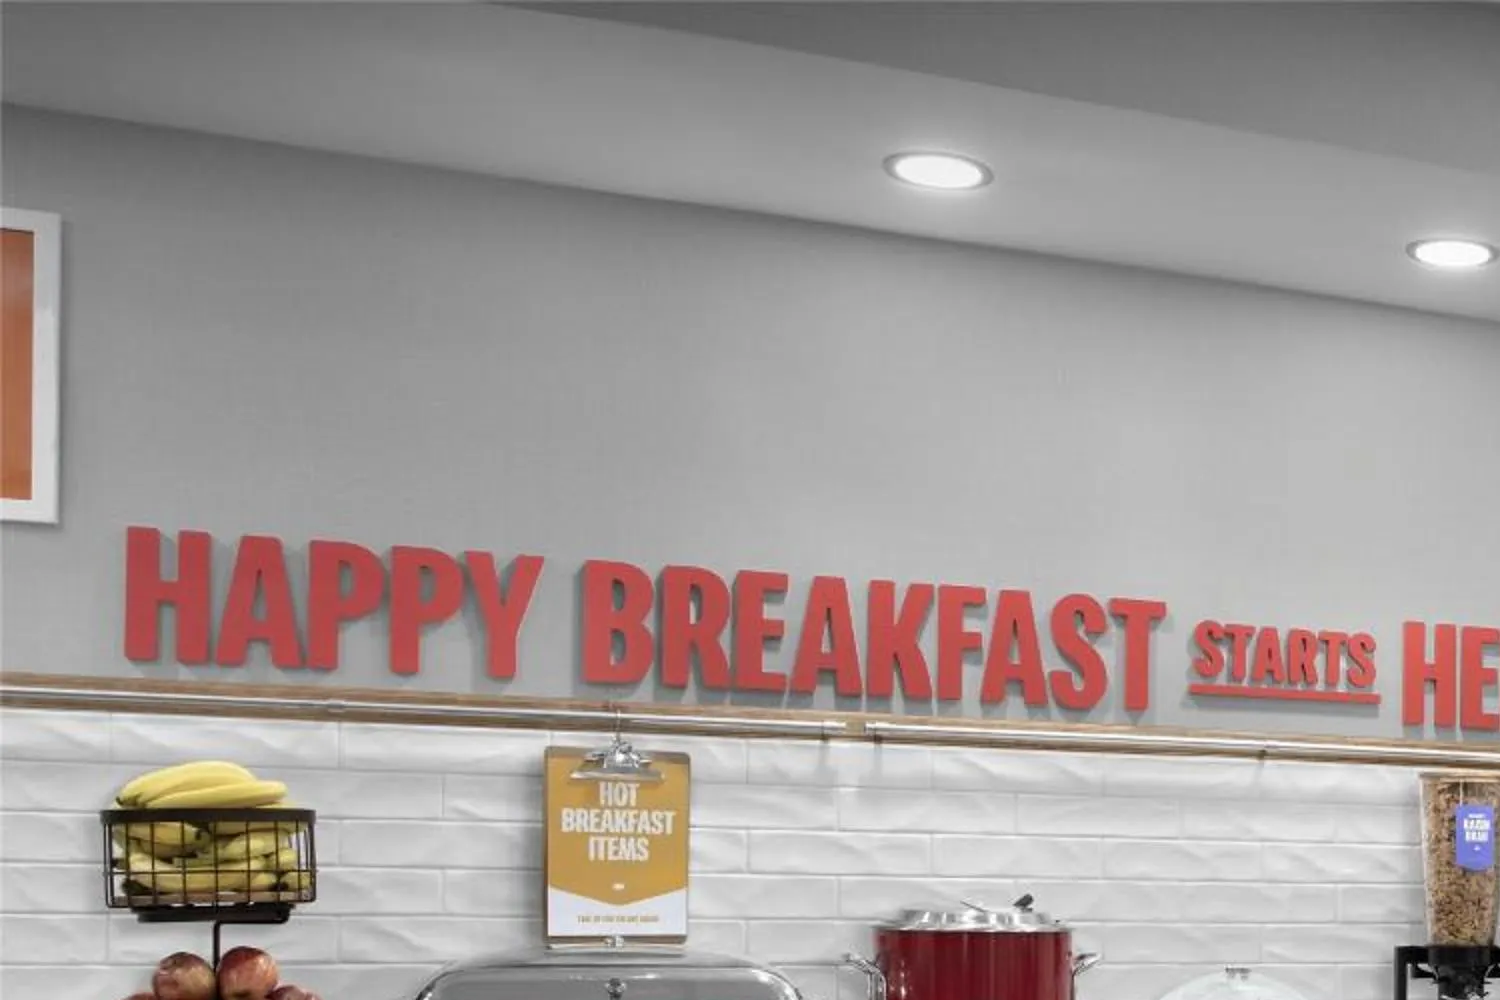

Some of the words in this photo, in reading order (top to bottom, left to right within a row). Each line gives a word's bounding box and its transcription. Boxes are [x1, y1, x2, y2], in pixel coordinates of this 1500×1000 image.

[125, 526, 545, 679] HAPPY
[580, 559, 1167, 712] BREAKFAST
[1191, 619, 1377, 688] STARTS
[600, 780, 641, 807] HOT
[561, 808, 677, 836] BREAKFAST
[588, 836, 650, 862] ITEMS
